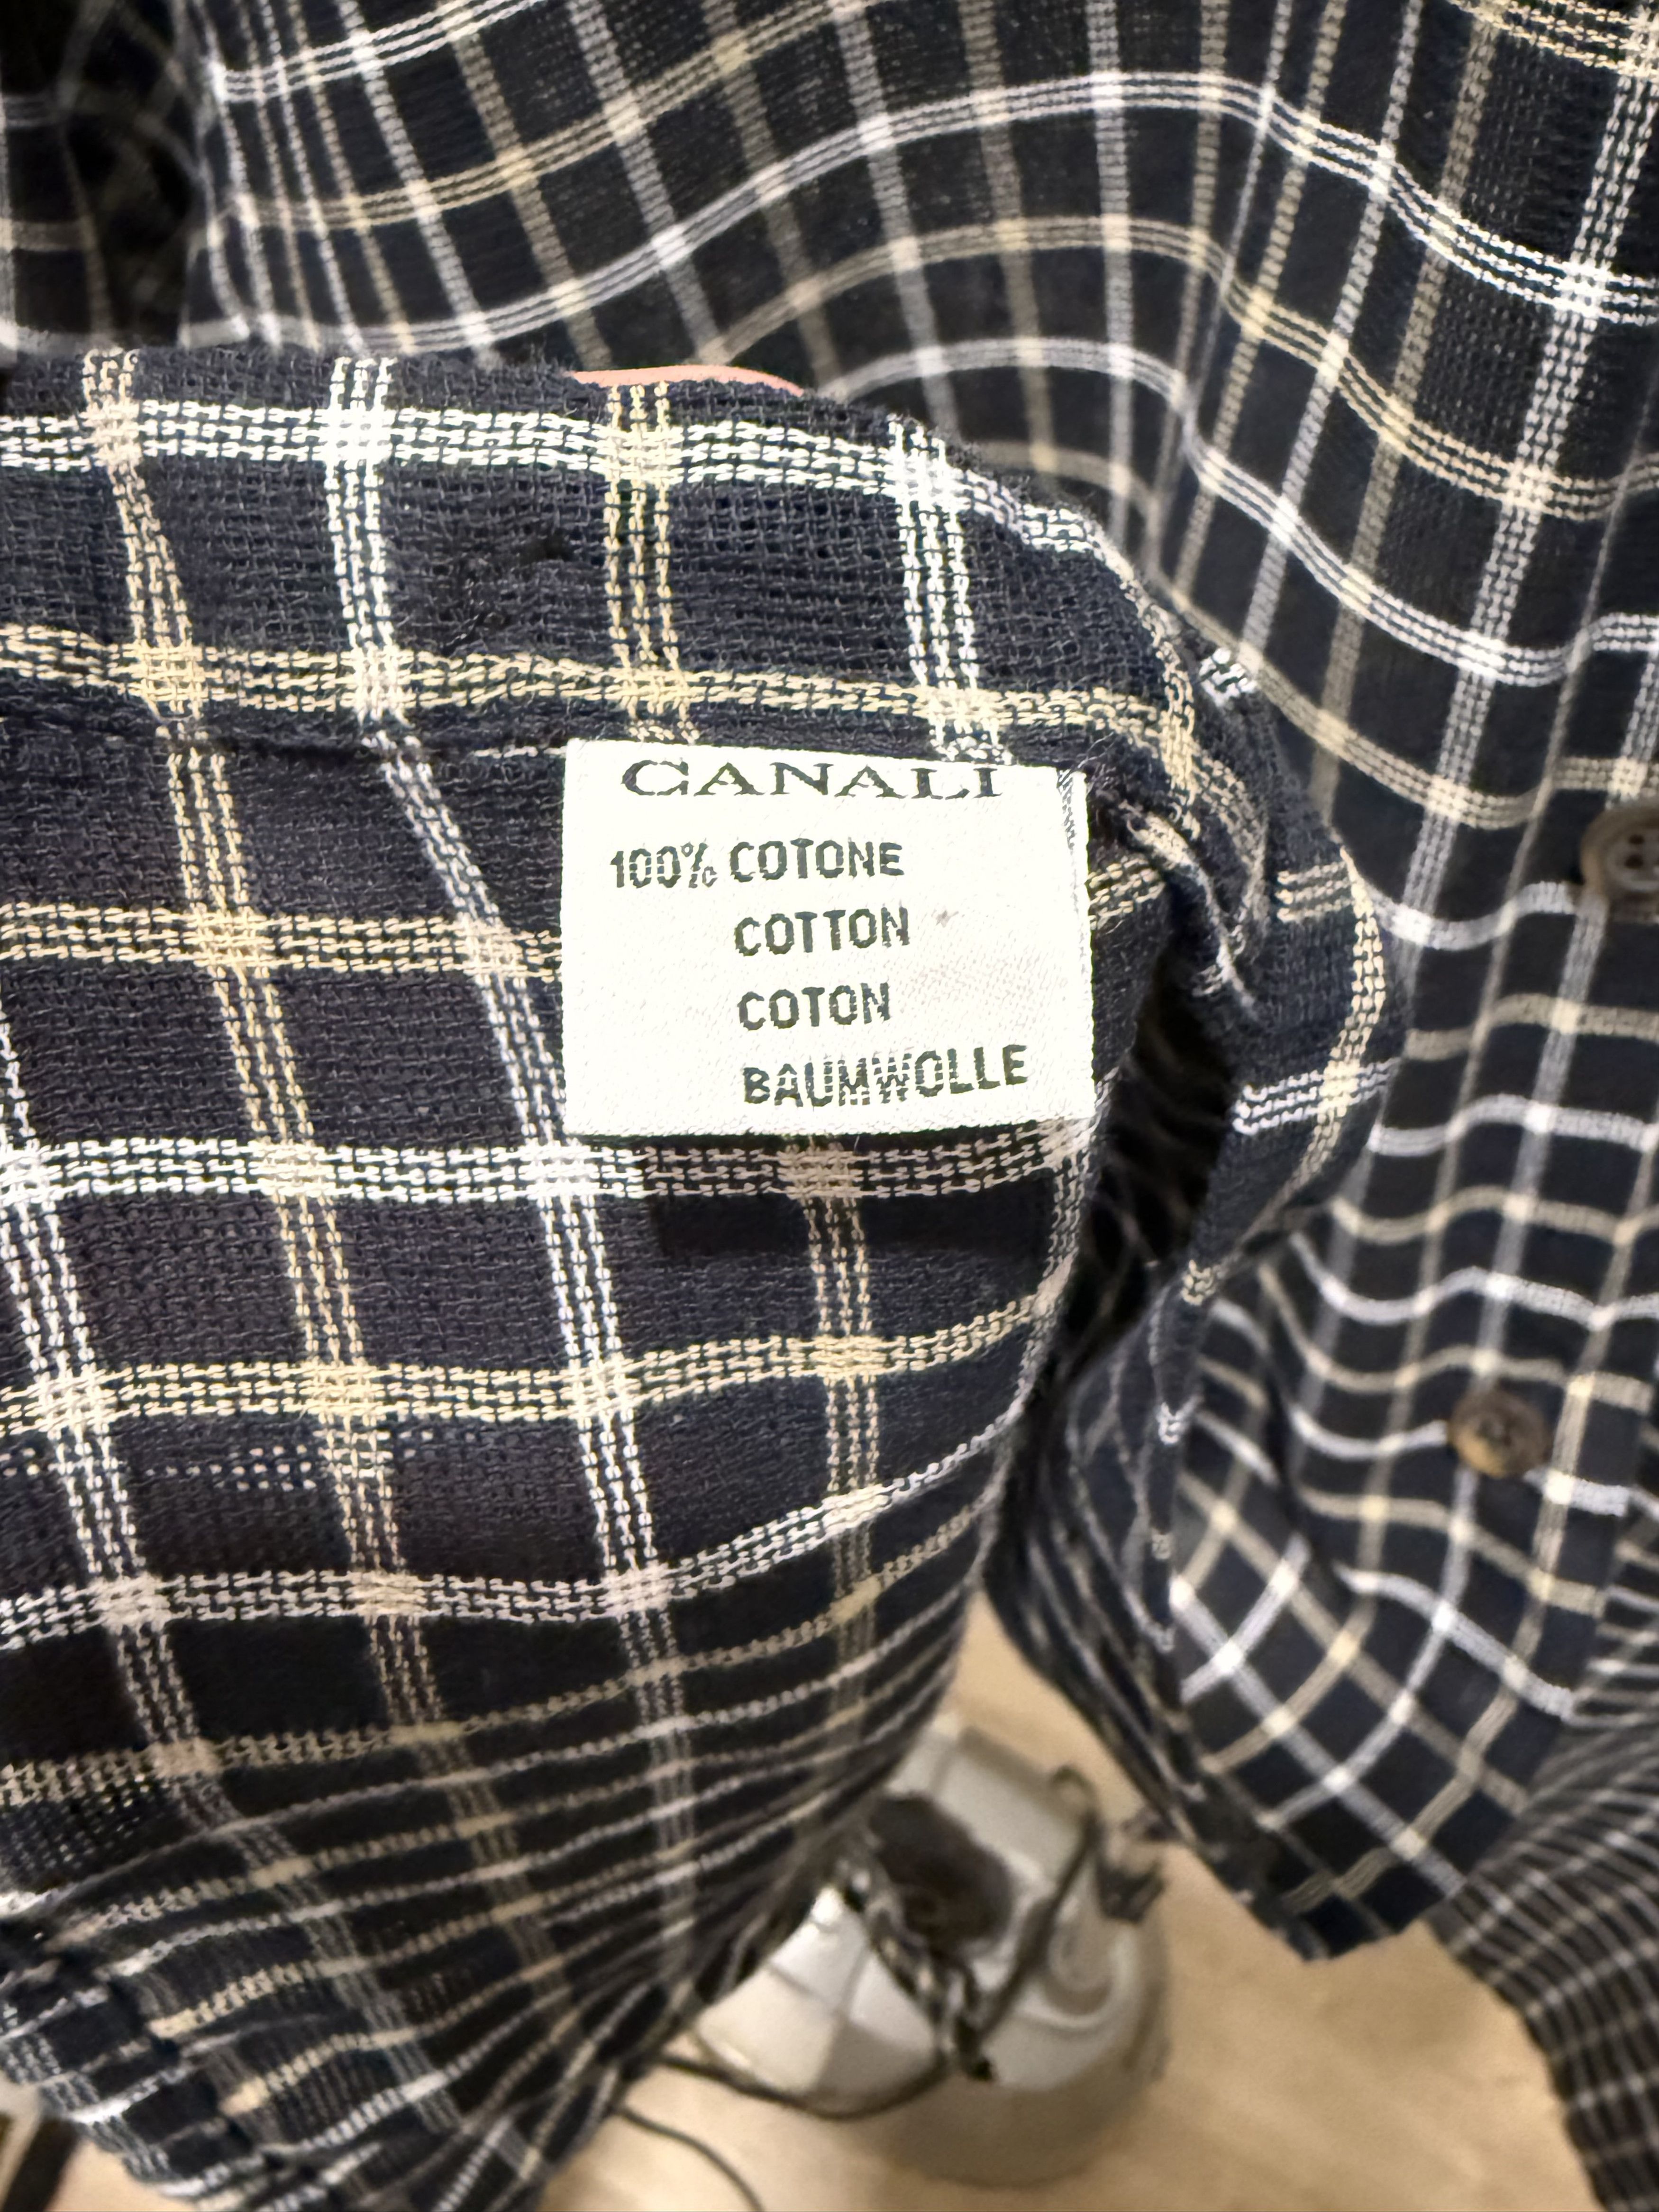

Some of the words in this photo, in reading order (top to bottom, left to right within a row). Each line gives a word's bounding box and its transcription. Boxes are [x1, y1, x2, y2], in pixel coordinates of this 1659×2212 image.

[620, 759, 1003, 800] CANALI
[610, 841, 718, 889] 100%
[729, 837, 904, 883] COTONE
[734, 906, 910, 956] COTTON
[737, 983, 890, 1031] COTON
[743, 1044, 1028, 1107] BAUMWOLLE
